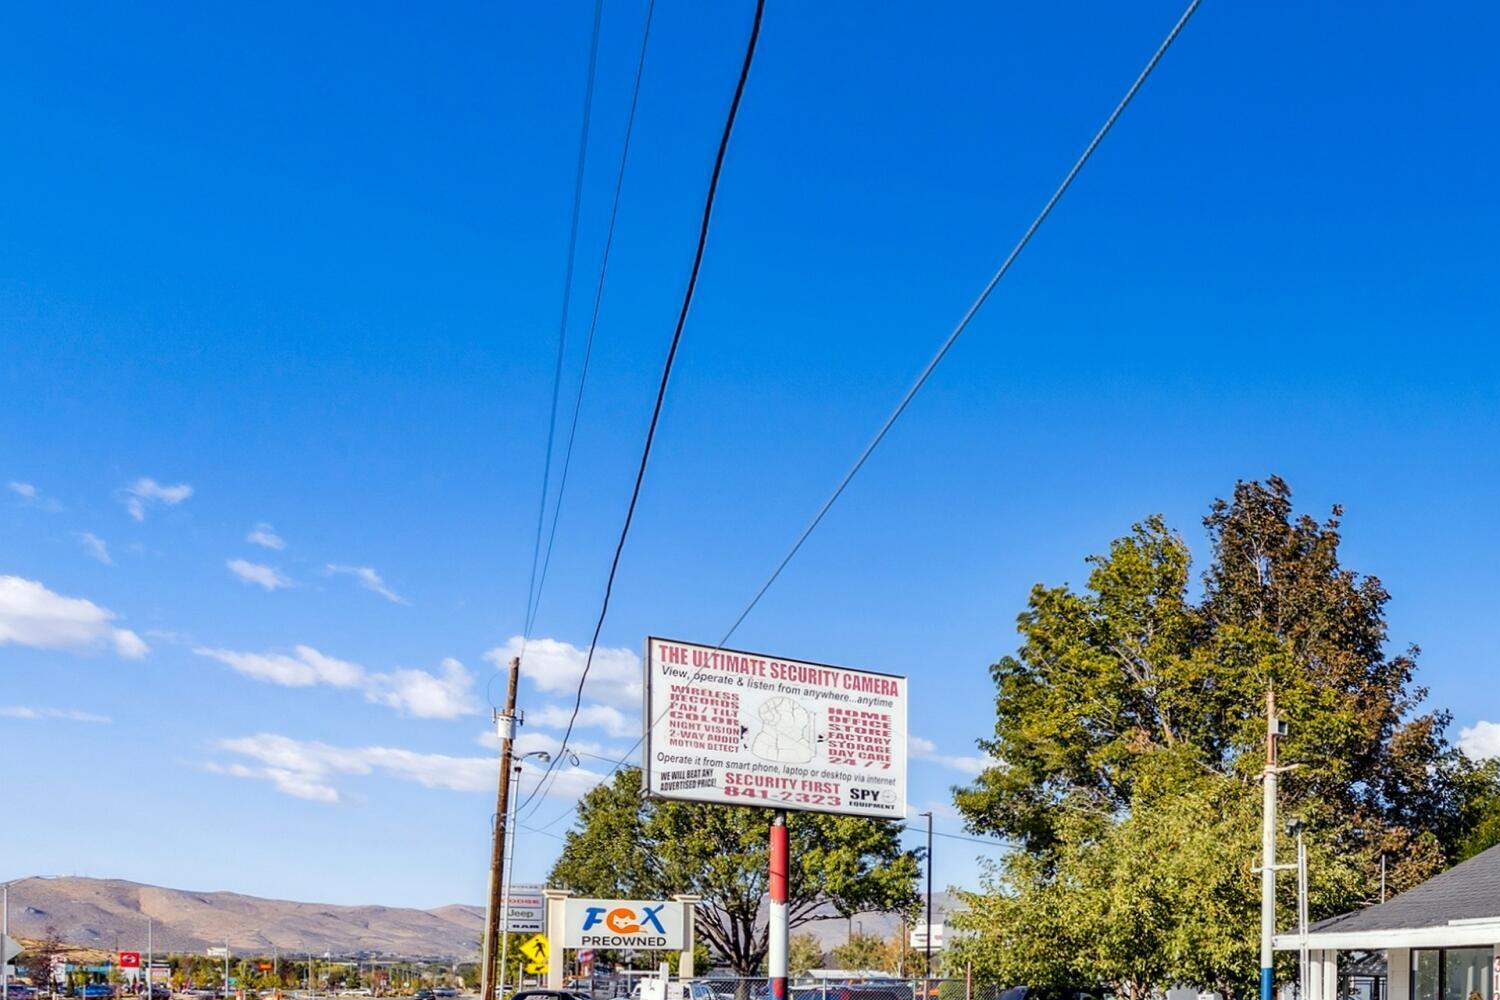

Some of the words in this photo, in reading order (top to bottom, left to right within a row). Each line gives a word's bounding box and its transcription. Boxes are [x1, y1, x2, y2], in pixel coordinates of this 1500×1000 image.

[659, 645, 688, 665] THE
[692, 650, 766, 676] ULTIMATE
[770, 662, 839, 688] SECURITY
[843, 673, 899, 697] CAMERA
[662, 665, 690, 680] View,
[693, 671, 733, 685] operate
[737, 677, 744, 686] &
[747, 677, 775, 691] listen
[778, 683, 800, 695] from
[671, 685, 739, 700] WIRELESS
[670, 694, 739, 709] RECORDS
[670, 702, 697, 712] PAN
[714, 708, 739, 717] TILT
[828, 707, 891, 721] HOME
[670, 711, 739, 726] COLOR
[828, 716, 891, 729] OFFICE
[669, 720, 701, 730] NIGHT
[704, 725, 739, 735] VISION
[828, 724, 891, 737] STORE
[669, 729, 704, 740] 2-WAY
[708, 734, 739, 744] AUDIO
[828, 732, 891, 745] FACTORY
[669, 739, 705, 749] MOTION
[707, 744, 739, 753] DETECT
[828, 740, 891, 753] STORAGE
[828, 749, 854, 757] DAY
[858, 752, 891, 761] CARE
[657, 752, 693, 765] Operate
[695, 756, 701, 766] it
[703, 757, 723, 768] from
[725, 761, 750, 771] smart
[752, 763, 780, 774] phone,
[783, 765, 808, 778] laptop
[821, 769, 852, 783] desktop
[854, 774, 865, 782] via
[867, 775, 896, 786] internet
[661, 772, 670, 780] WE
[672, 770, 685, 780] WILL
[686, 769, 700, 779] BEAT
[702, 768, 713, 777] ANY
[660, 780, 696, 791] ADVERTISED
[697, 779, 717, 788] PRICE!
[725, 772, 797, 790] SECURITY
[801, 780, 841, 794] FIRST
[724, 786, 841, 806] 841-2323
[850, 788, 880, 801] SPY
[849, 801, 895, 810] EQUIPMENT
[507, 909, 534, 918] Jeep
[582, 936, 667, 946] PREOWNED
